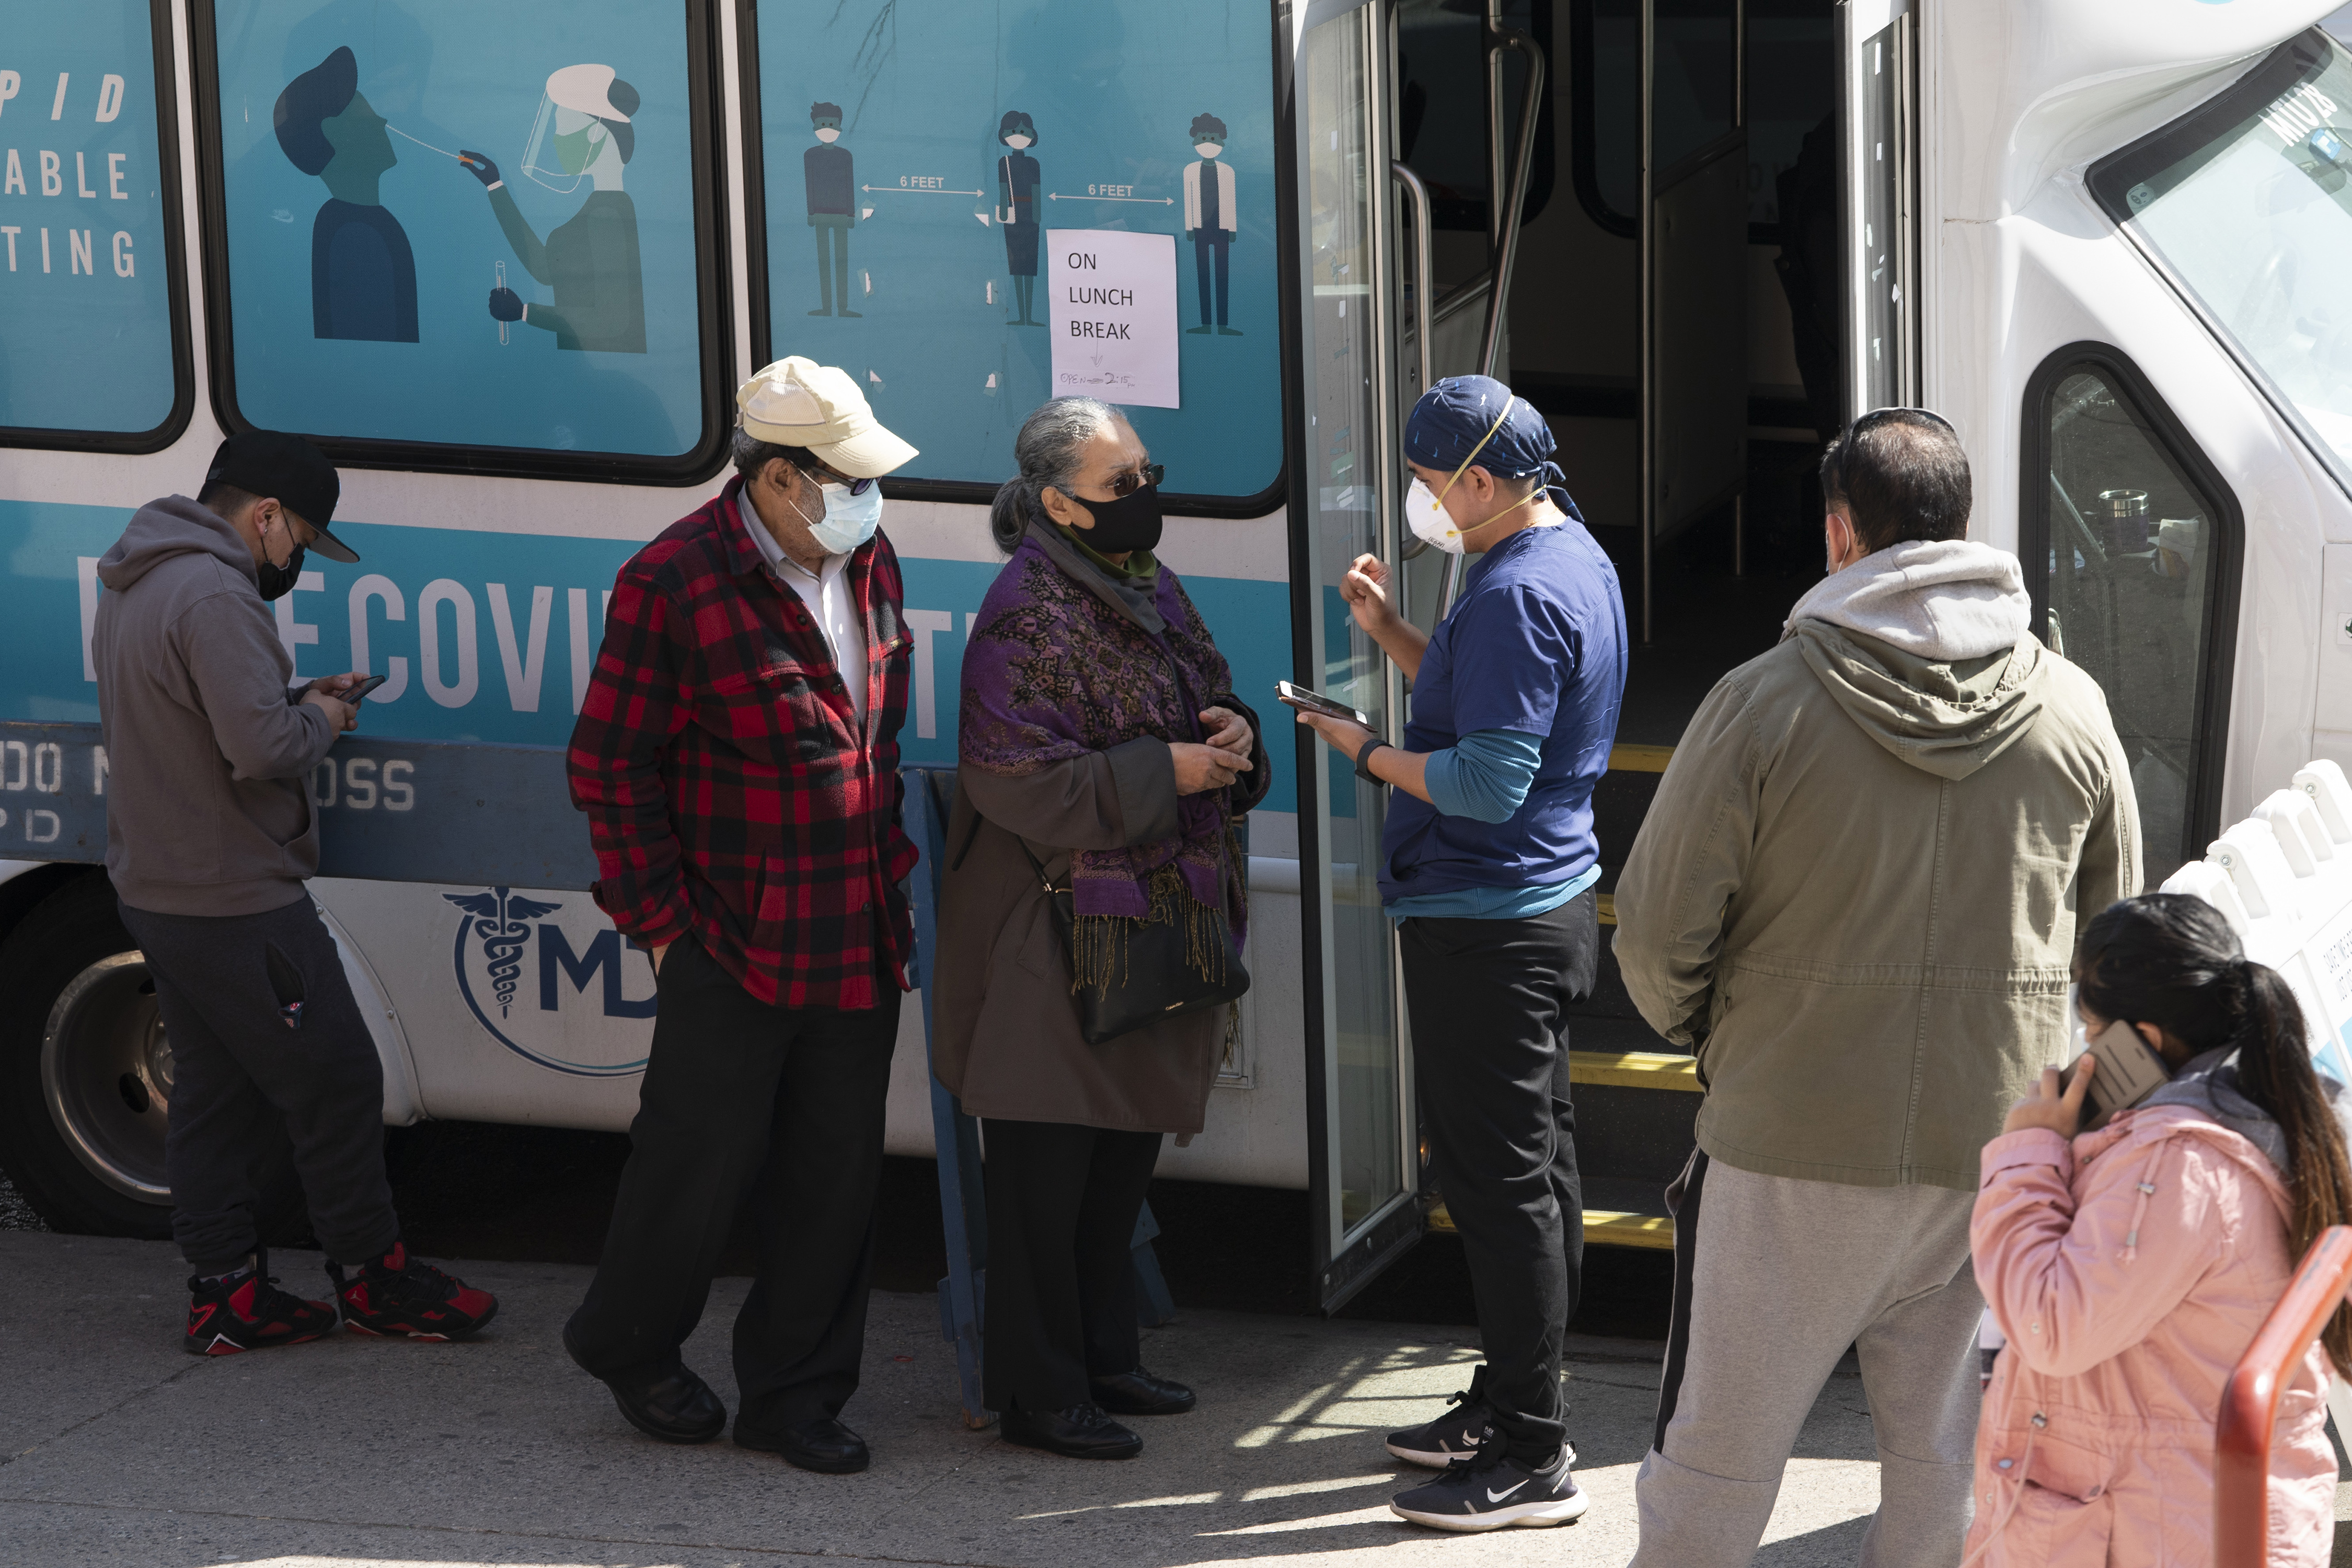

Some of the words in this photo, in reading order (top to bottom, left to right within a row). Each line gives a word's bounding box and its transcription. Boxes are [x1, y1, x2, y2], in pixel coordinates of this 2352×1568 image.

[5, 149, 128, 199] ABLE
[900, 176, 907, 187] 6
[911, 176, 944, 188] FEET
[1088, 184, 1096, 195] 6
[1099, 185, 1134, 197] FEET
[1, 226, 134, 277] TING
[1068, 253, 1096, 270] ON
[1069, 287, 1132, 306] LUNCH
[1071, 321, 1131, 340] BREAK
[1060, 373, 1086, 385] OPEN
[349, 574, 610, 715] COVI
[0, 741, 61, 792] DO
[311, 757, 414, 811] OSS
